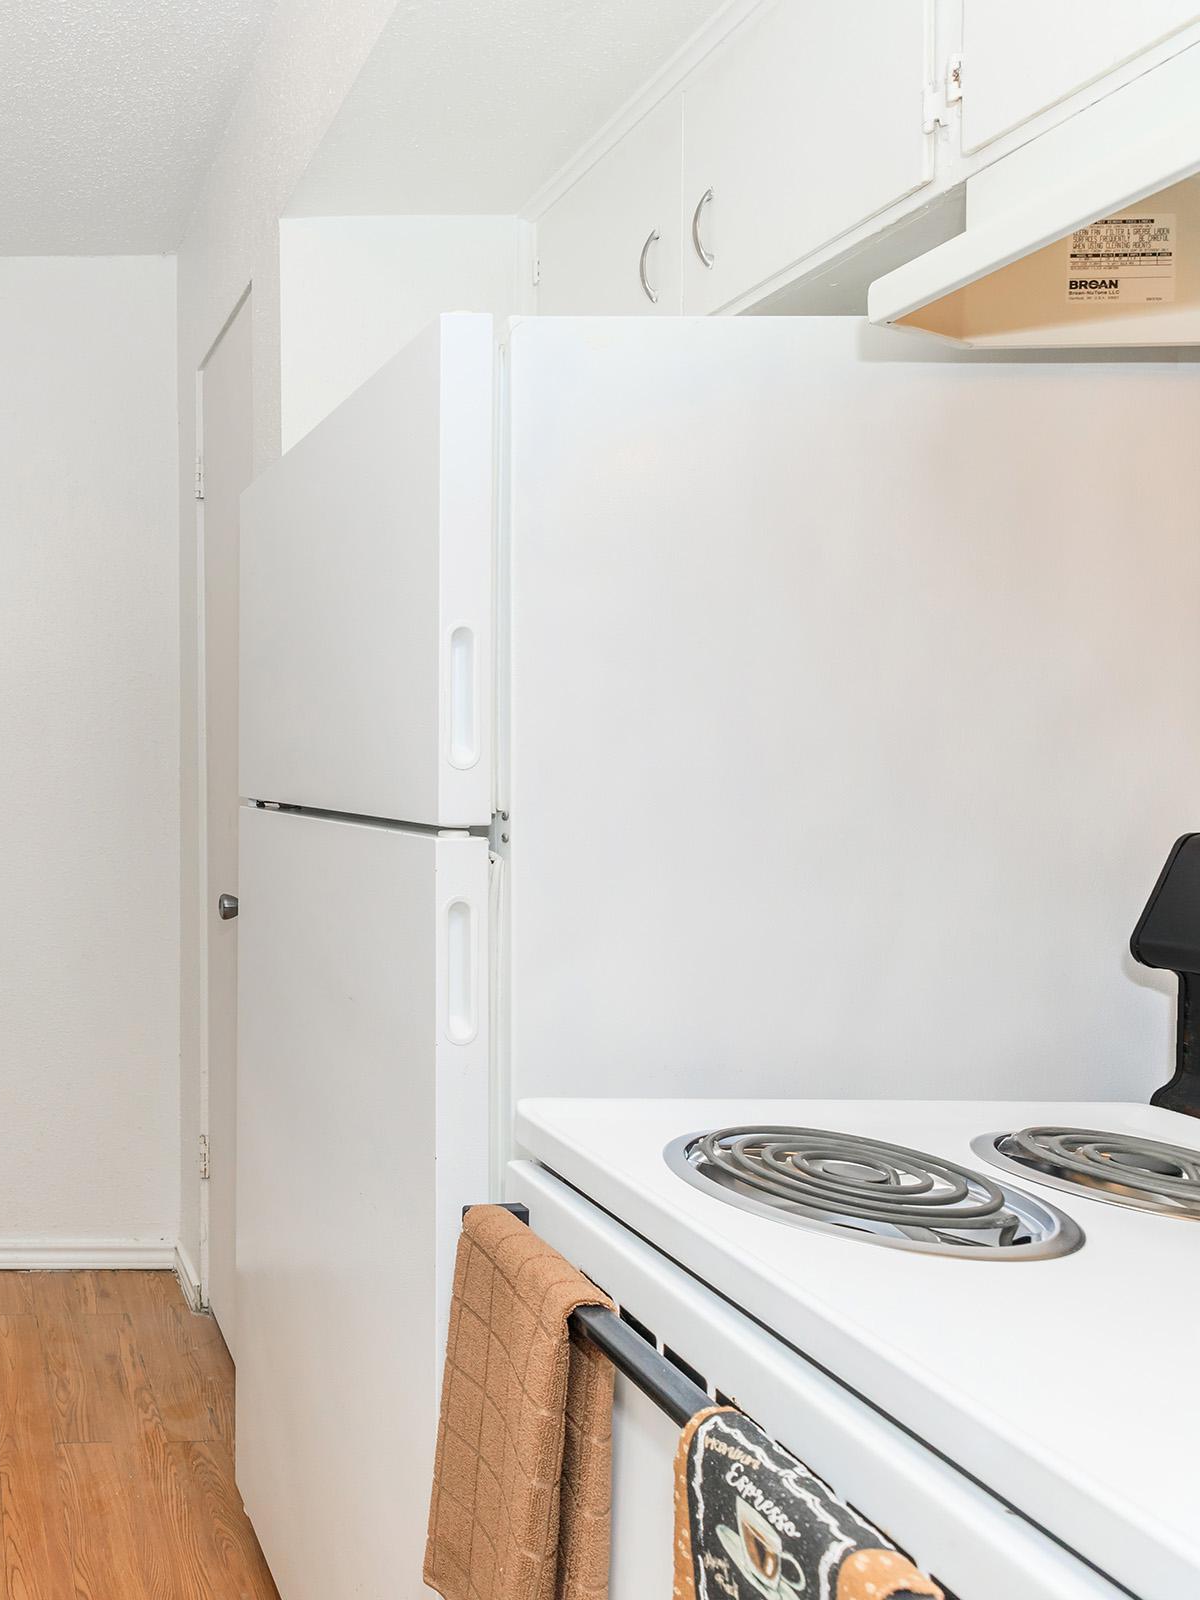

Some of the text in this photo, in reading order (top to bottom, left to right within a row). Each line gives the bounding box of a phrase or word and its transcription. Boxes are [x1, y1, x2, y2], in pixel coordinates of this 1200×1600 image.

[1073, 235, 1097, 243] SURFACES
[1069, 279, 1118, 290] BROAN
[725, 1462, 802, 1538] Espresso
